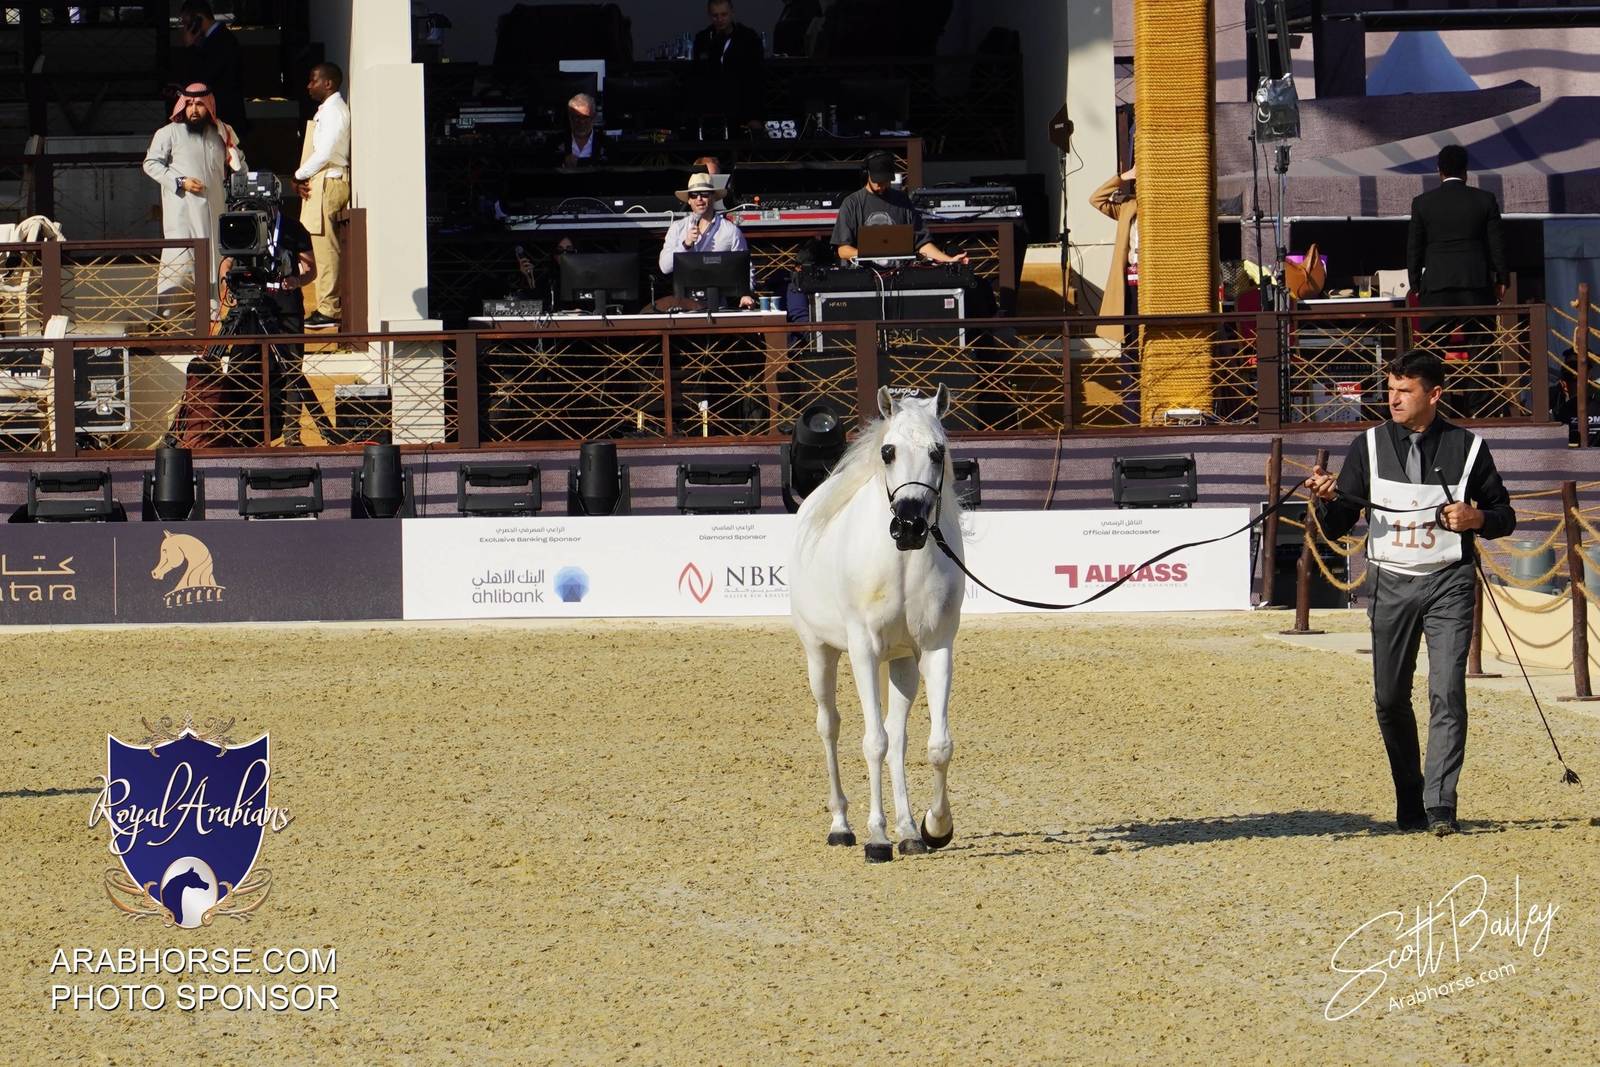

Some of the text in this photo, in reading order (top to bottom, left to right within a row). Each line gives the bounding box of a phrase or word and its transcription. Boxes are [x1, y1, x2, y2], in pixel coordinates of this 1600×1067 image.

[516, 536, 548, 544] Banking
[734, 534, 767, 542] Sponsor
[1392, 519, 1436, 550] 113
[517, 569, 545, 587] البنك
[725, 565, 787, 587] NBK
[1085, 563, 1189, 583] ALKASS
[471, 588, 545, 604] ahlibank
